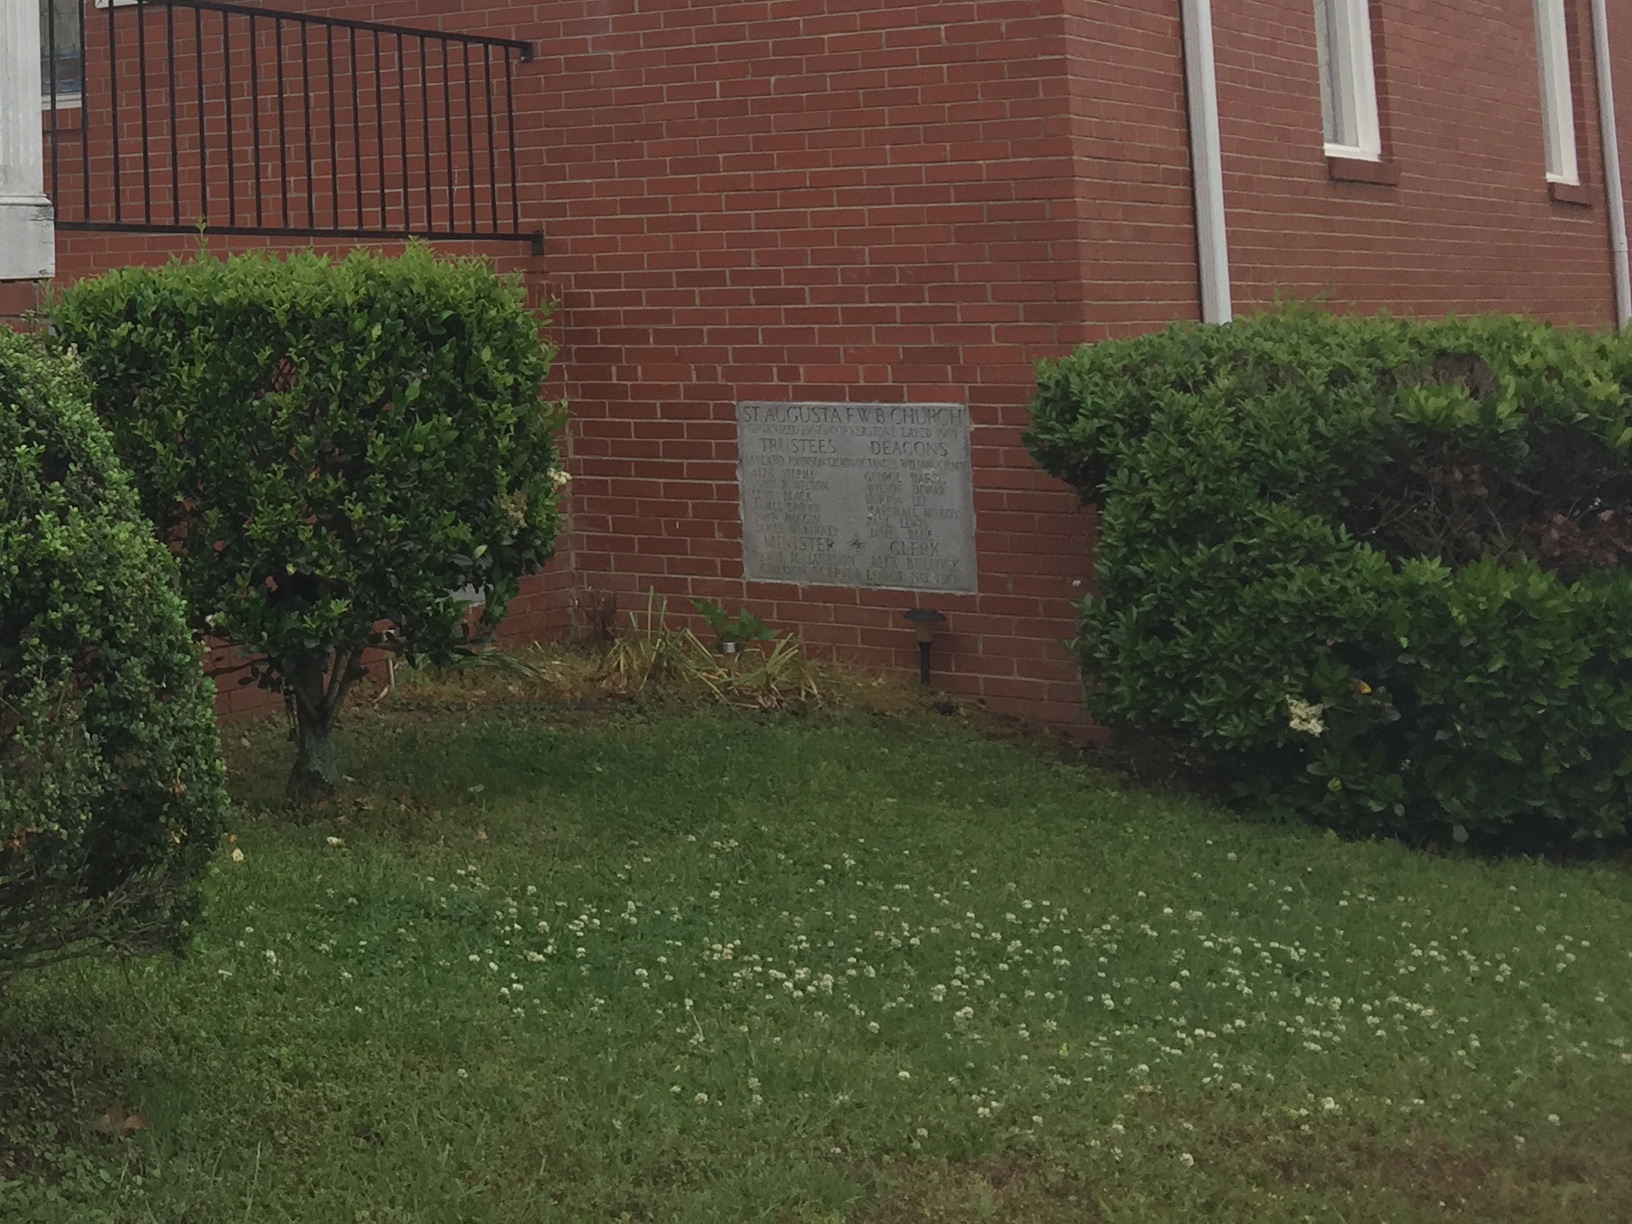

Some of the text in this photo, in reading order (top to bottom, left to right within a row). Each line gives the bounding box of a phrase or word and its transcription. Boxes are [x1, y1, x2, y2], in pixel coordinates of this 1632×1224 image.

[763, 404, 843, 424] AUGUSTA
[889, 406, 963, 426] CHURCH
[758, 436, 837, 454] TRUSTEES
[869, 439, 949, 457] DEACONS
[888, 540, 941, 558] CLERK
